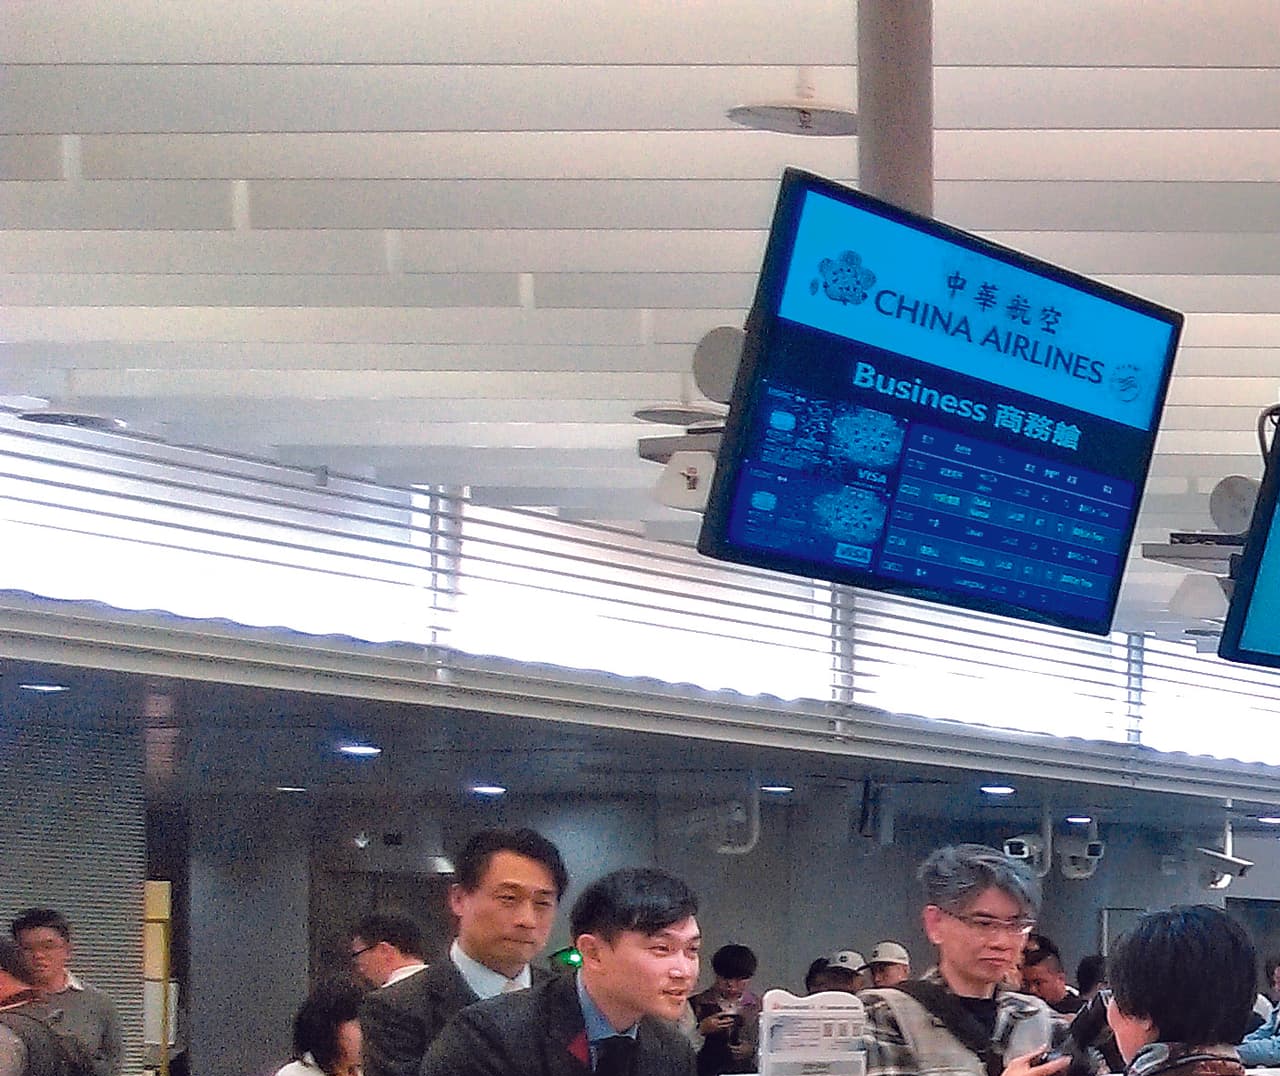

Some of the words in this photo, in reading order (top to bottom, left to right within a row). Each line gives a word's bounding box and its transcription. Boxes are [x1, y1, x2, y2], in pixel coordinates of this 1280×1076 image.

[875, 289, 972, 343] CHINA
[980, 329, 1105, 385] AIRLINES
[946, 271, 1062, 335] 中華航空
[853, 361, 988, 423] Business
[995, 403, 1083, 451] 商務艙
[858, 468, 887, 484] VISA
